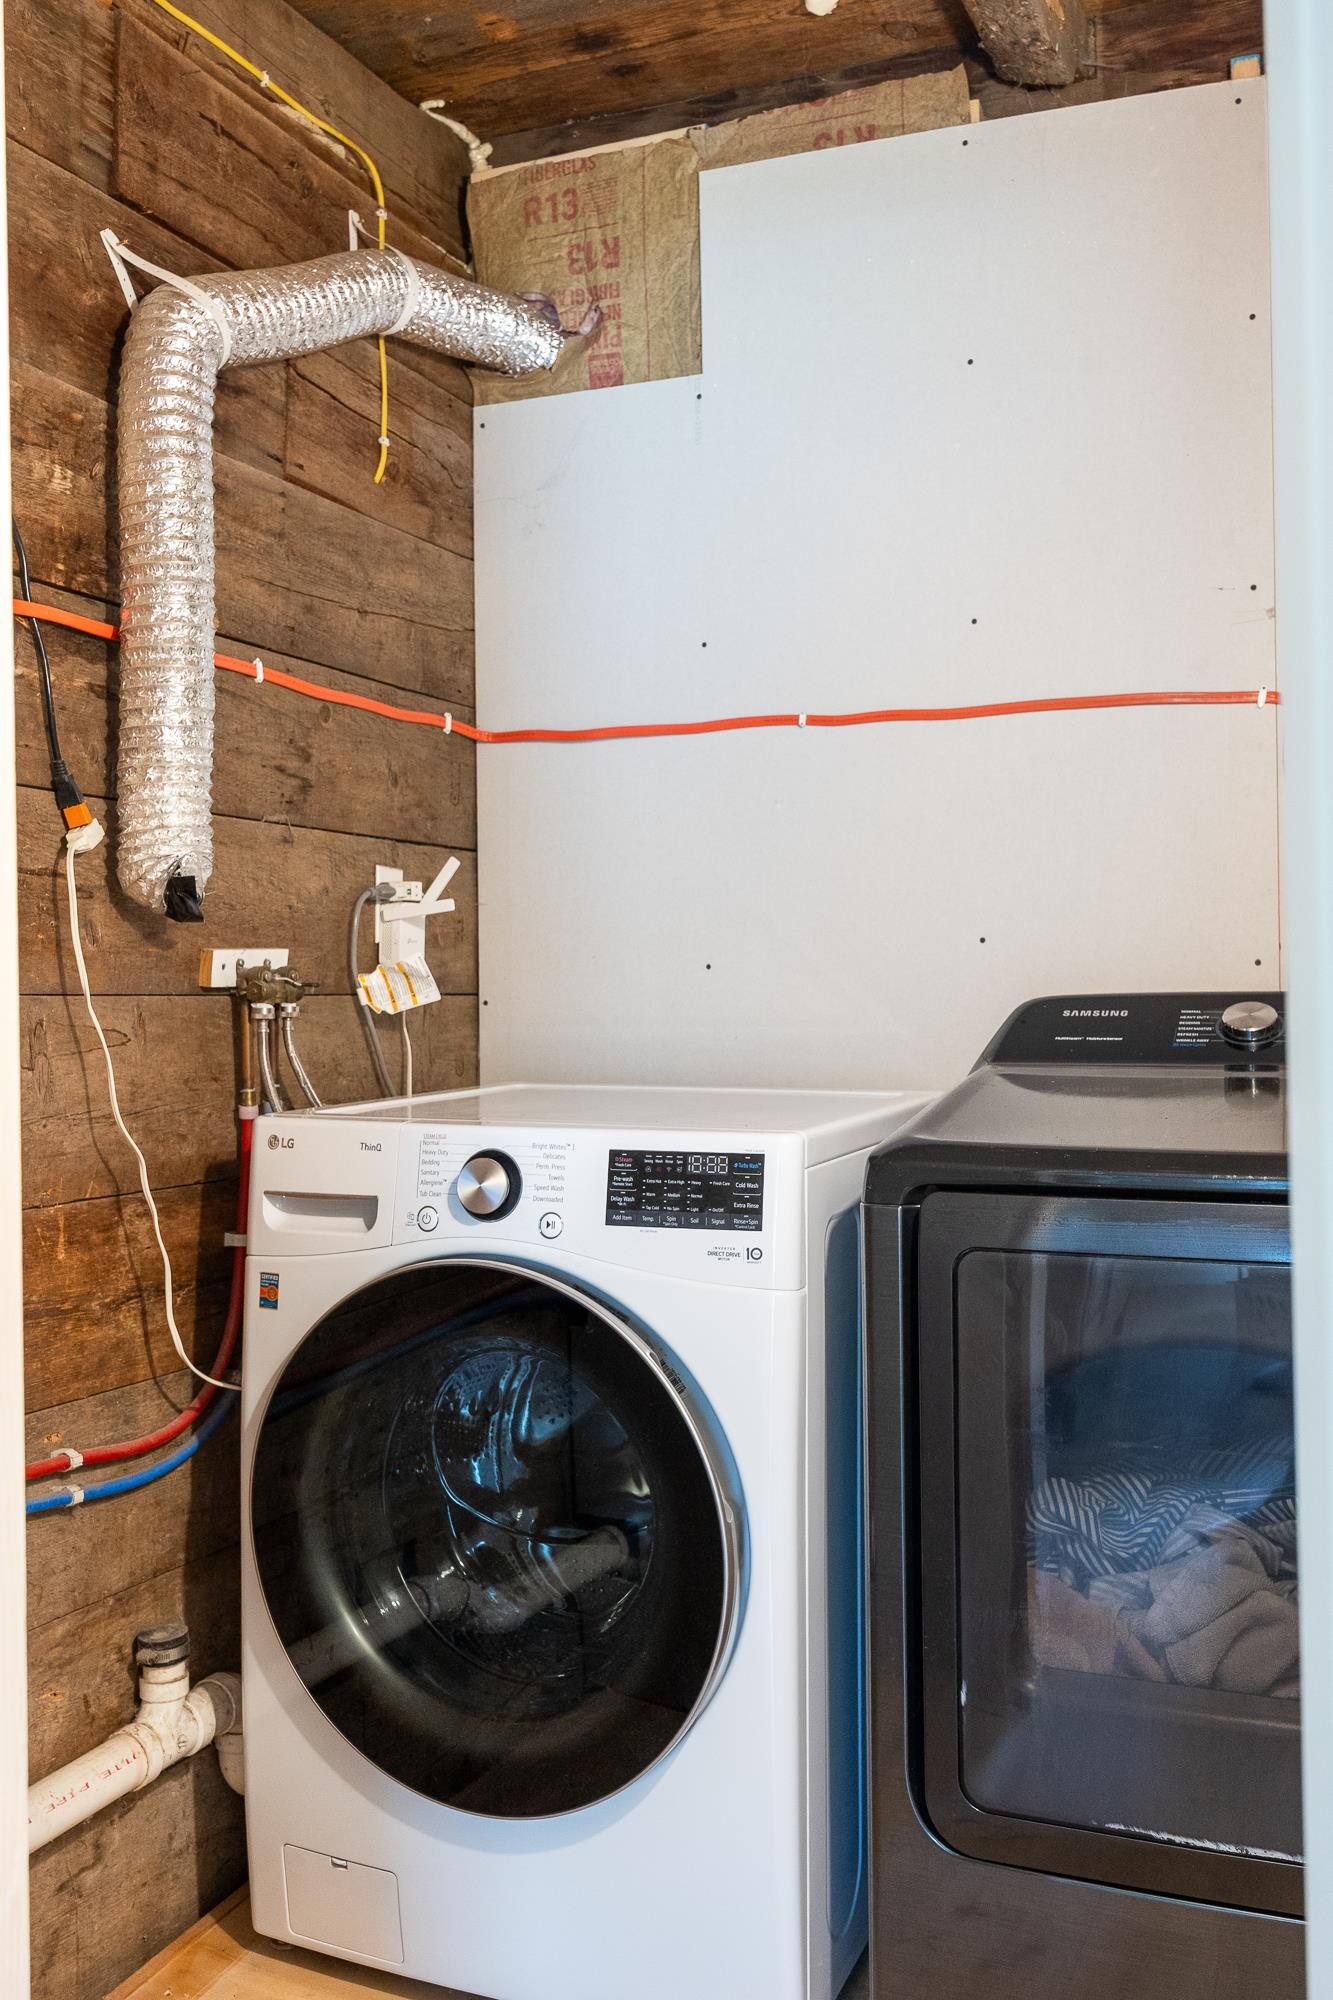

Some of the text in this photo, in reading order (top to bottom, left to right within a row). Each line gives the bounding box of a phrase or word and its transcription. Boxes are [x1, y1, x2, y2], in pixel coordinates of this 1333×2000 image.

[523, 187, 579, 228] R13
[567, 236, 621, 275] R13
[281, 1137, 295, 1149] LG
[360, 1142, 382, 1152] ThinQ
[746, 1247, 763, 1260] 10
